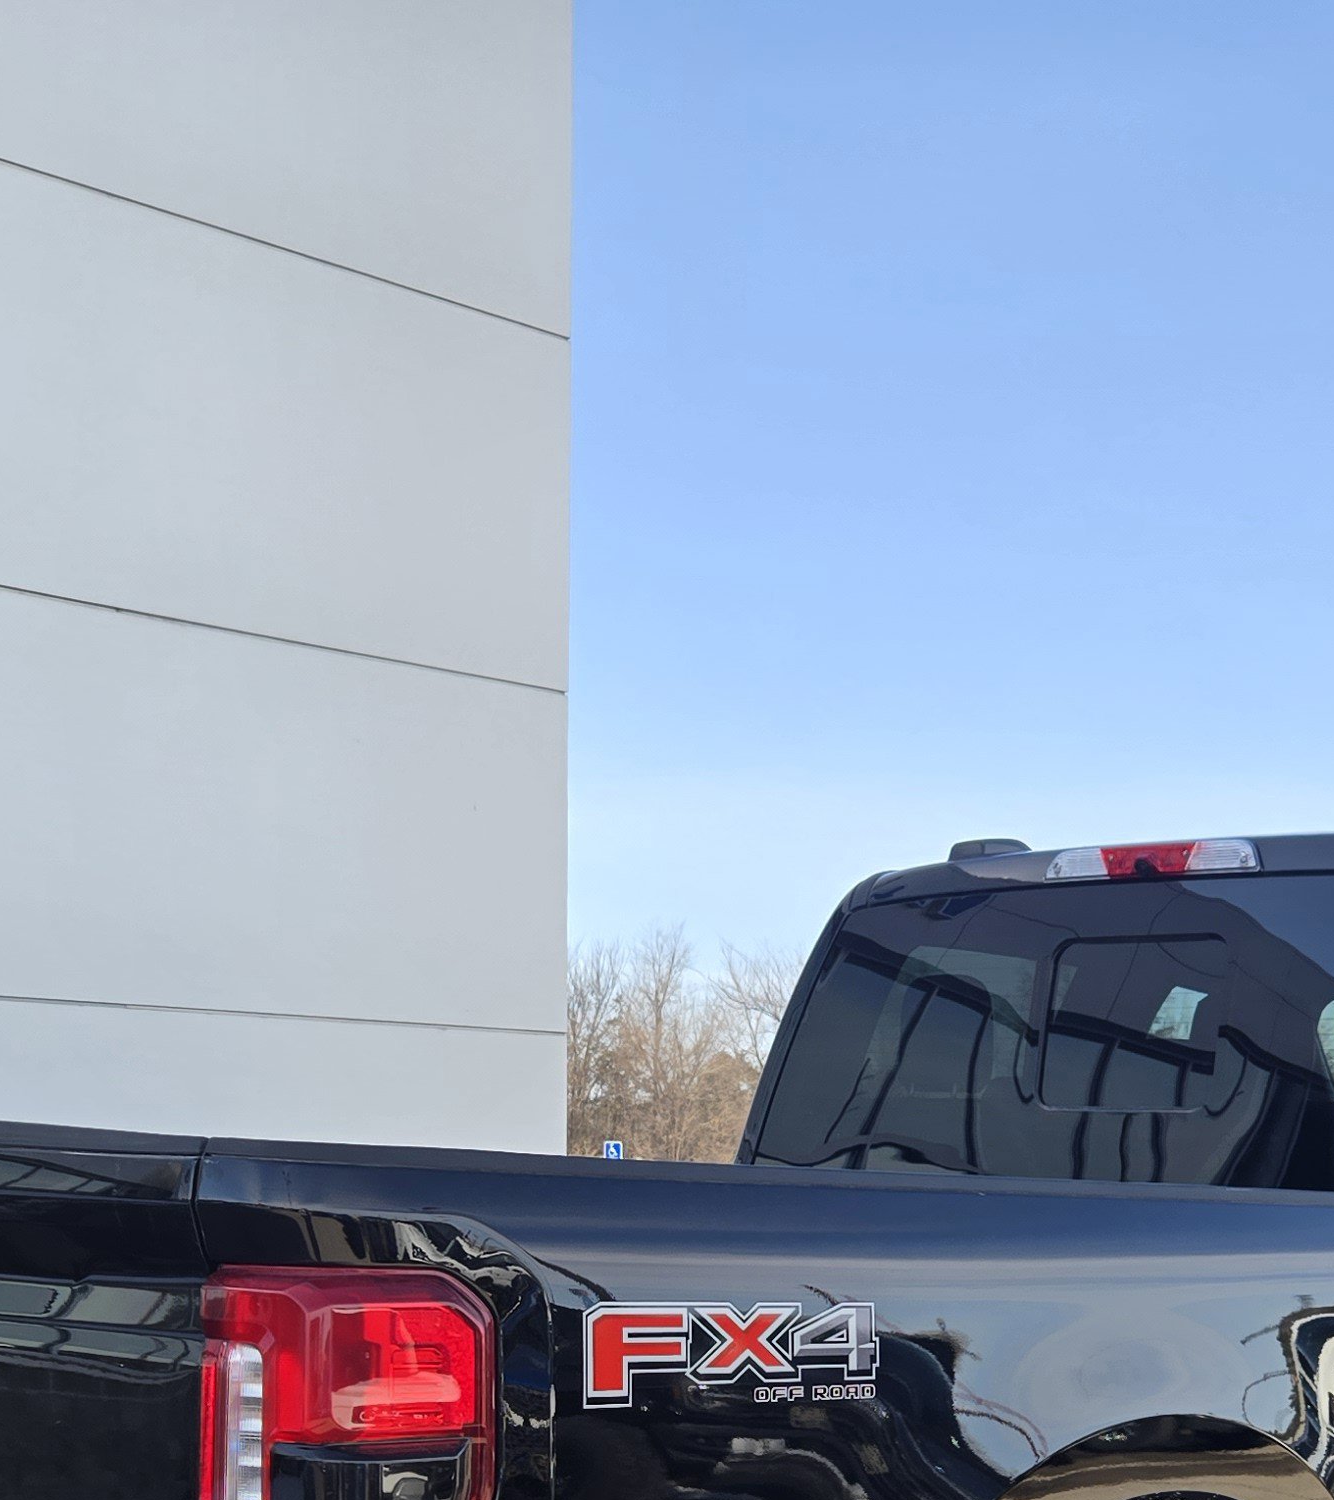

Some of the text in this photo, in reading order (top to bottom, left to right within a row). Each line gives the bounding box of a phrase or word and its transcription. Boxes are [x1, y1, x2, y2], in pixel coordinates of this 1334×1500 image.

[583, 1301, 879, 1409] FX4
[753, 1384, 876, 1402] OFF ROAD
